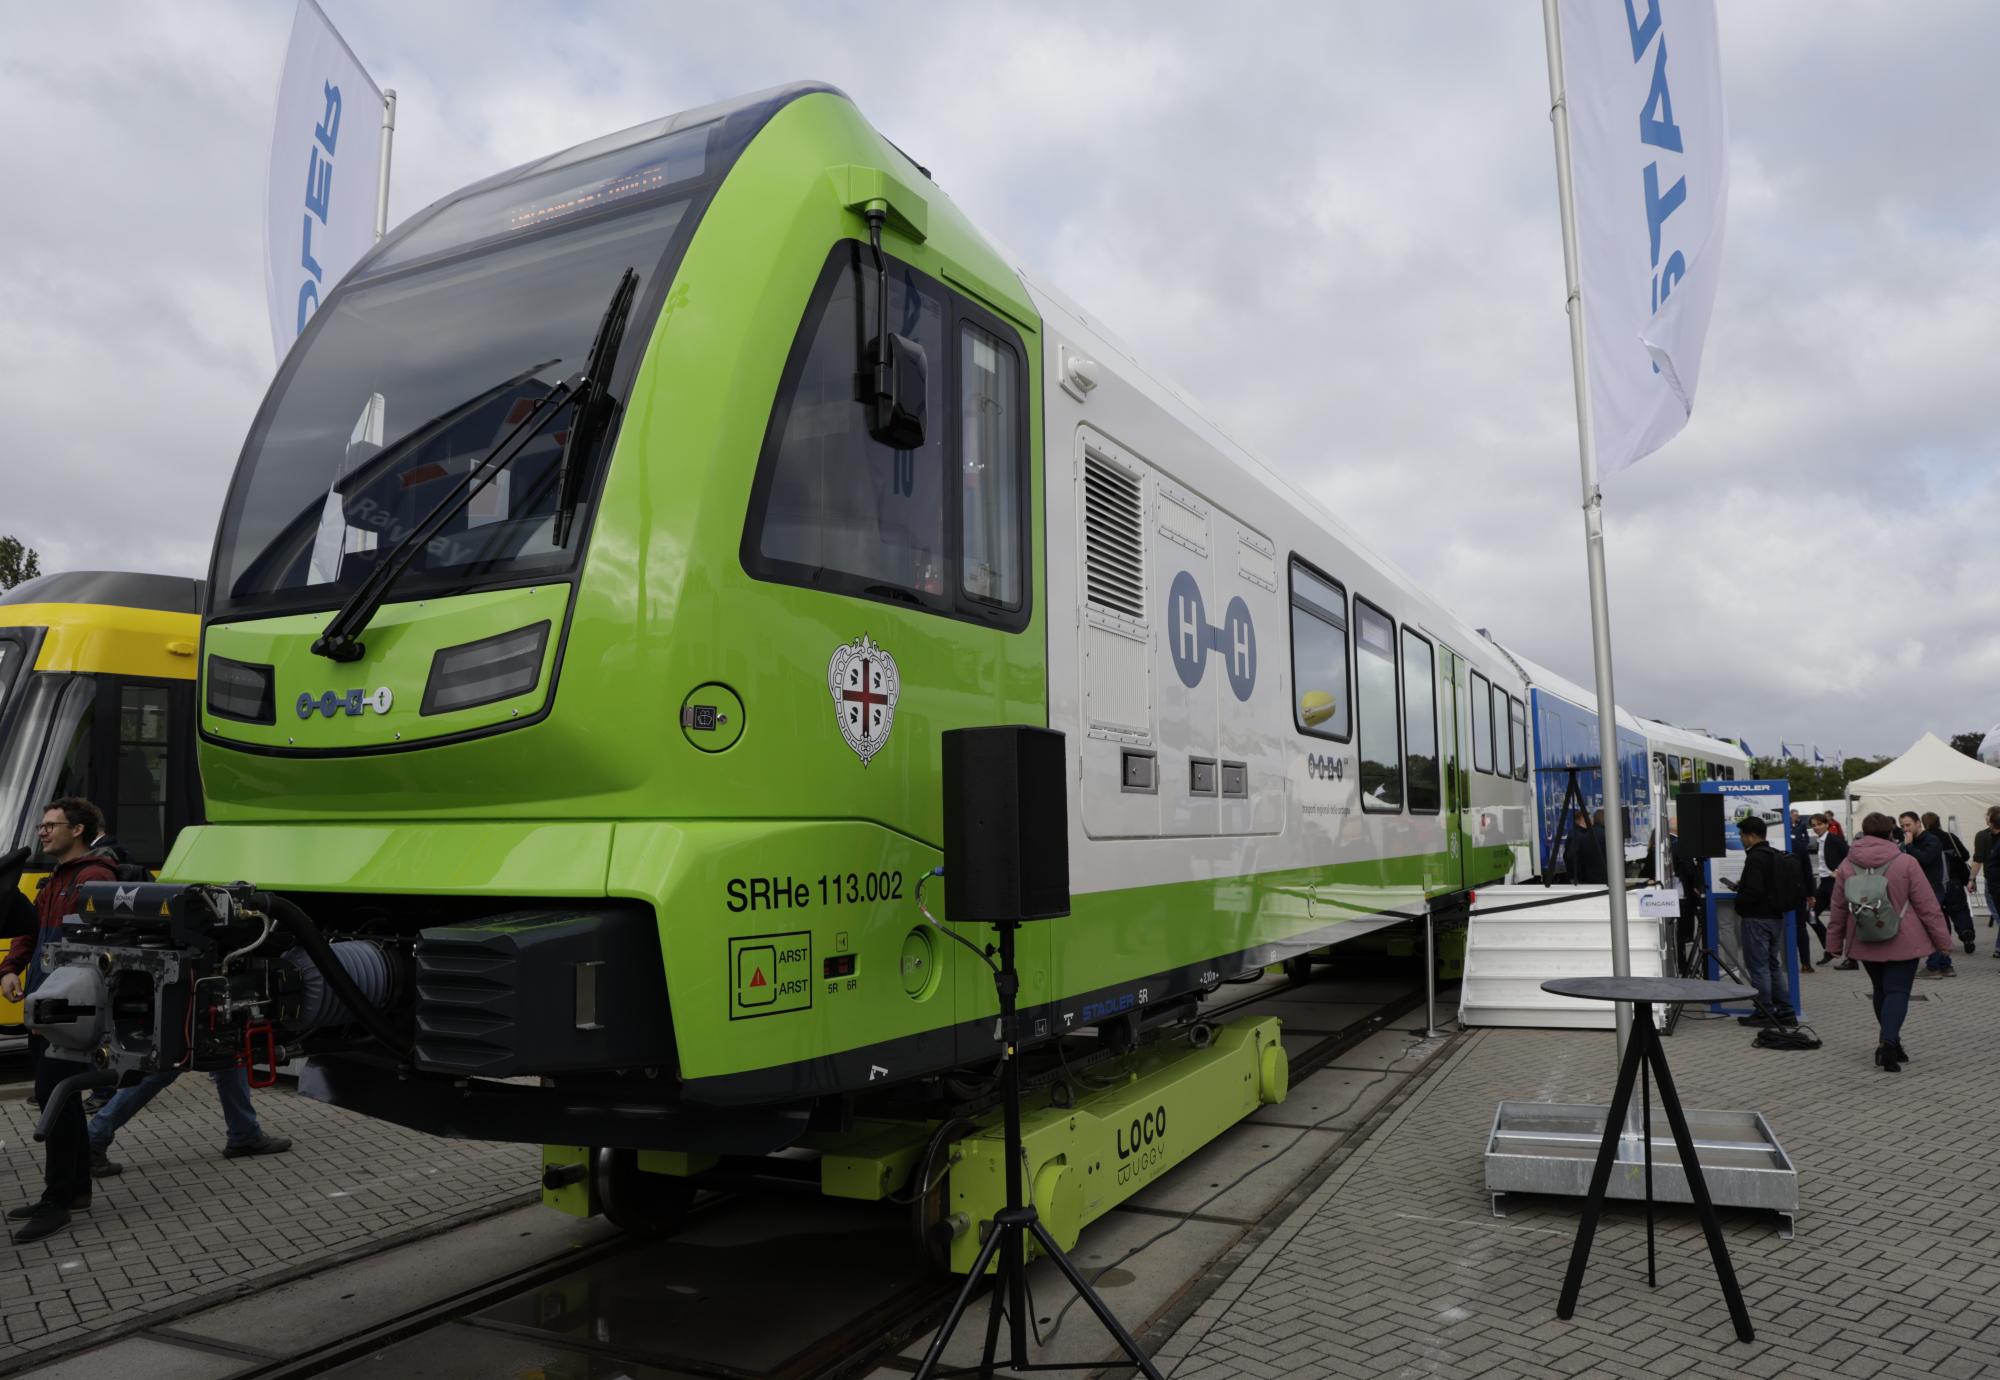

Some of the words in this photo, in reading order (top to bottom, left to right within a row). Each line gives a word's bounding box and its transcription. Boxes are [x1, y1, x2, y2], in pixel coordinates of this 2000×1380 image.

[1718, 784, 1772, 792] STADLER
[726, 876, 810, 913] SRHe
[818, 871, 903, 907] 113.002
[779, 949, 808, 964] ARST
[779, 979, 808, 995] ARST
[828, 983, 838, 994] 5R
[847, 979, 857, 990] 6R
[1081, 993, 1135, 1021] STADLER
[1138, 989, 1149, 1005] 5R
[1117, 1105, 1167, 1160] LOCO
